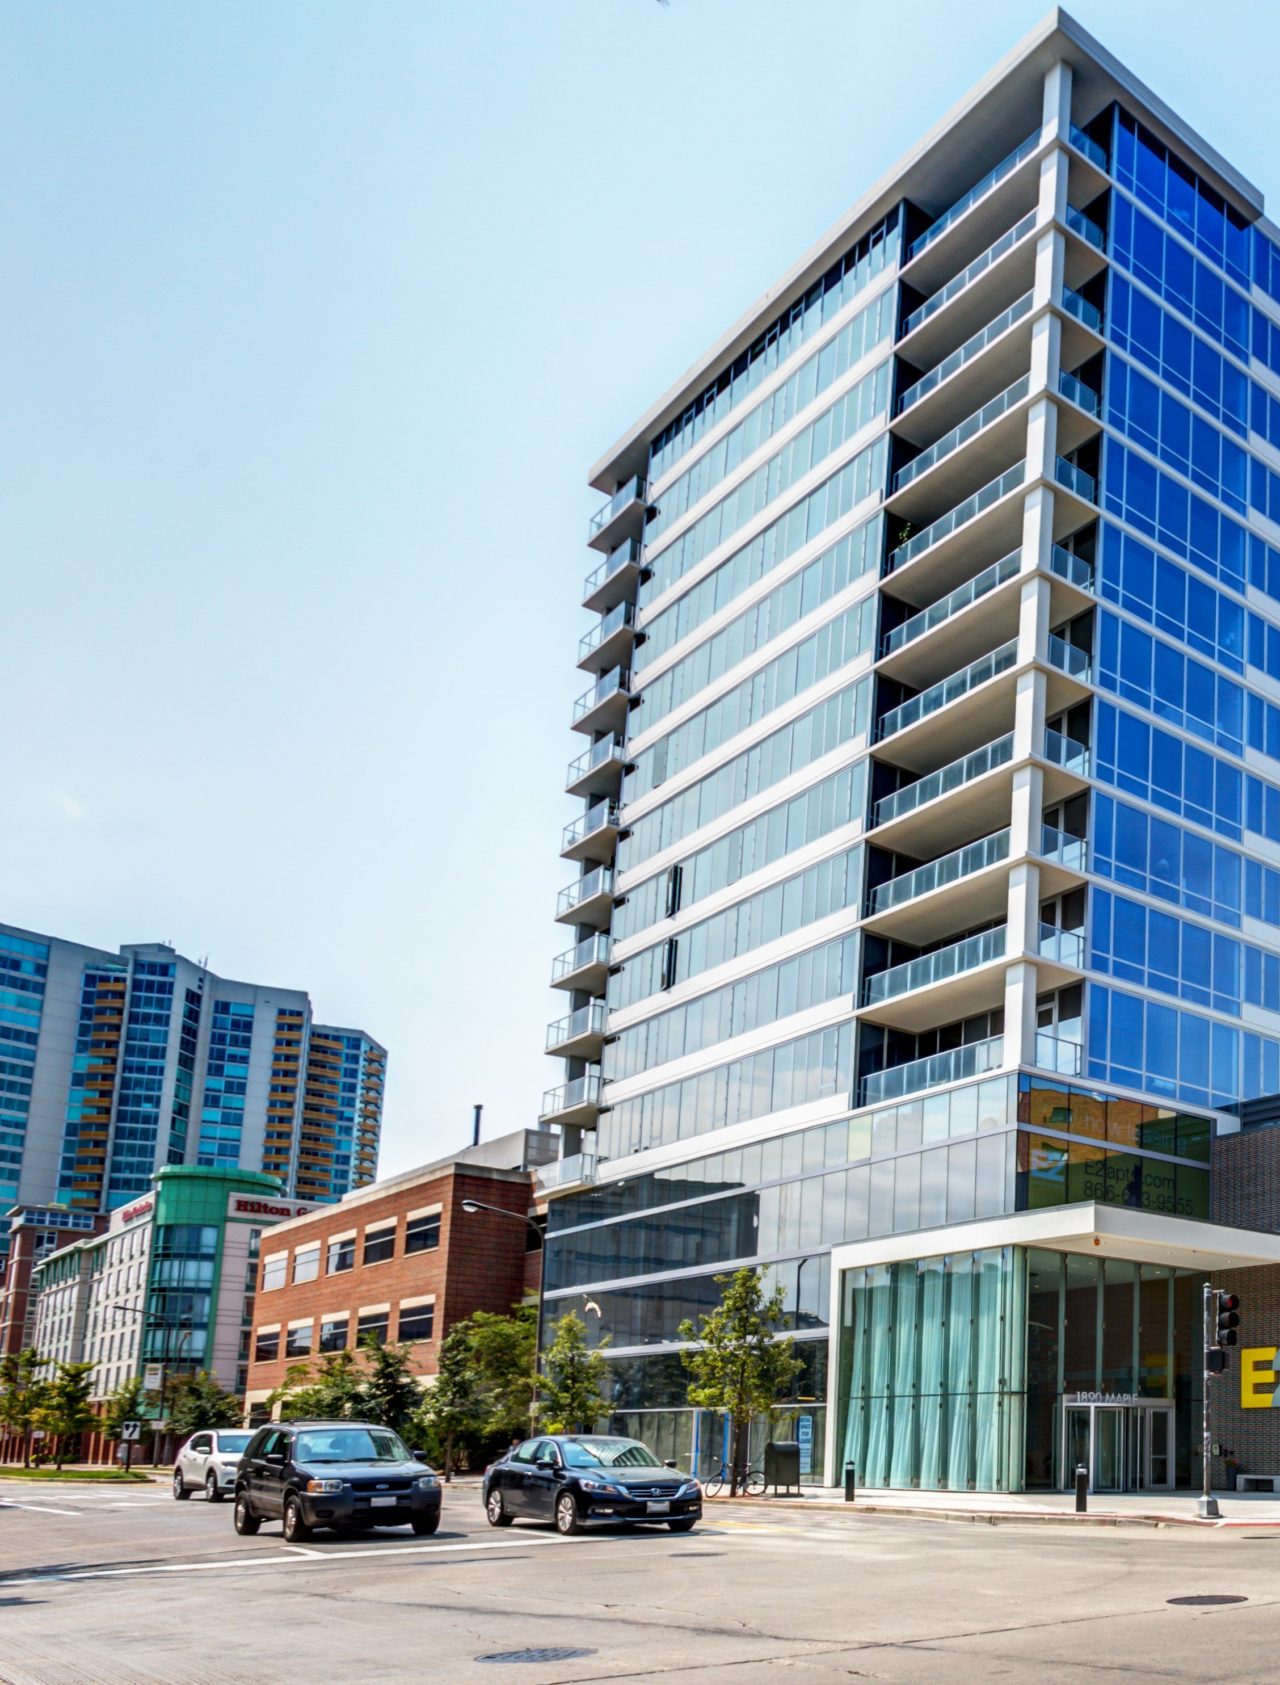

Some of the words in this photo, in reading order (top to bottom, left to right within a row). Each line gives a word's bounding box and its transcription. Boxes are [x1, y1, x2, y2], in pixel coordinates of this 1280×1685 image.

[1083, 1180, 1194, 1216] 866-63-9555
[234, 1199, 292, 1217] Hilton
[1076, 1391, 1102, 1403] 1890
